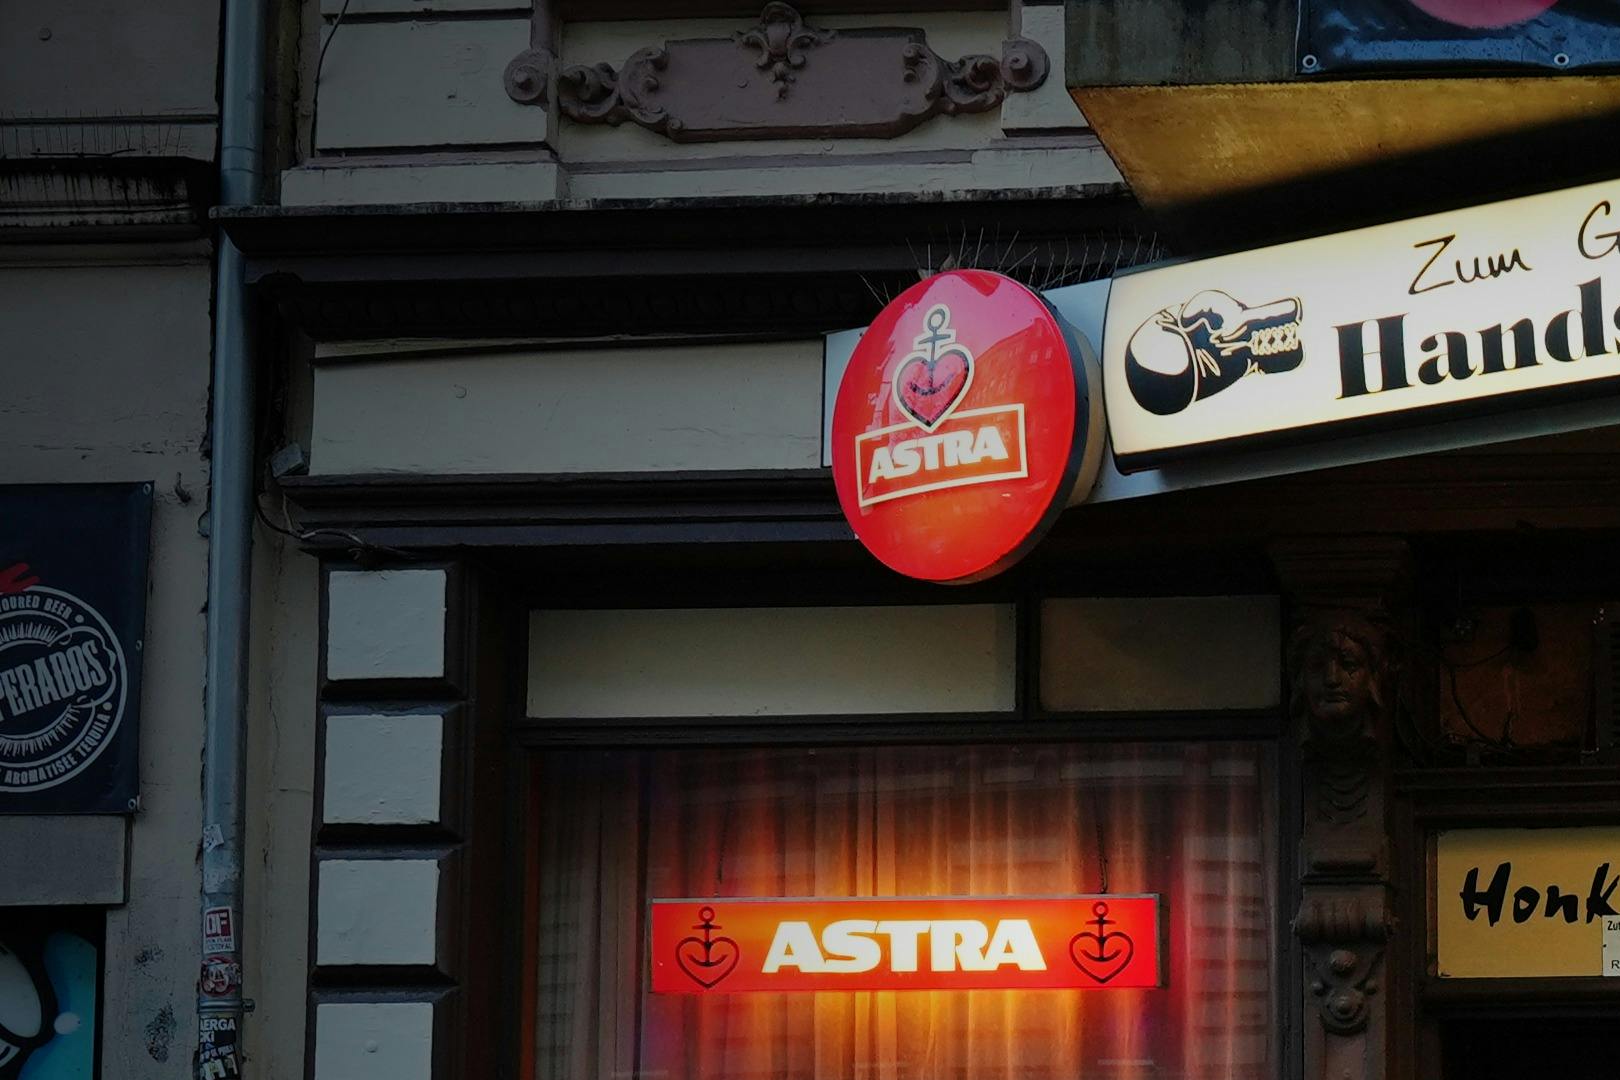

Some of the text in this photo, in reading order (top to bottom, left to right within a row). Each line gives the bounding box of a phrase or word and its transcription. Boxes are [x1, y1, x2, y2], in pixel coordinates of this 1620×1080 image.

[1408, 234, 1531, 296] Zum
[868, 425, 1009, 484] ASTRA
[0, 595, 40, 612] OURED
[75, 713, 112, 758] TEQUILA
[761, 918, 1048, 974] ASTRA
